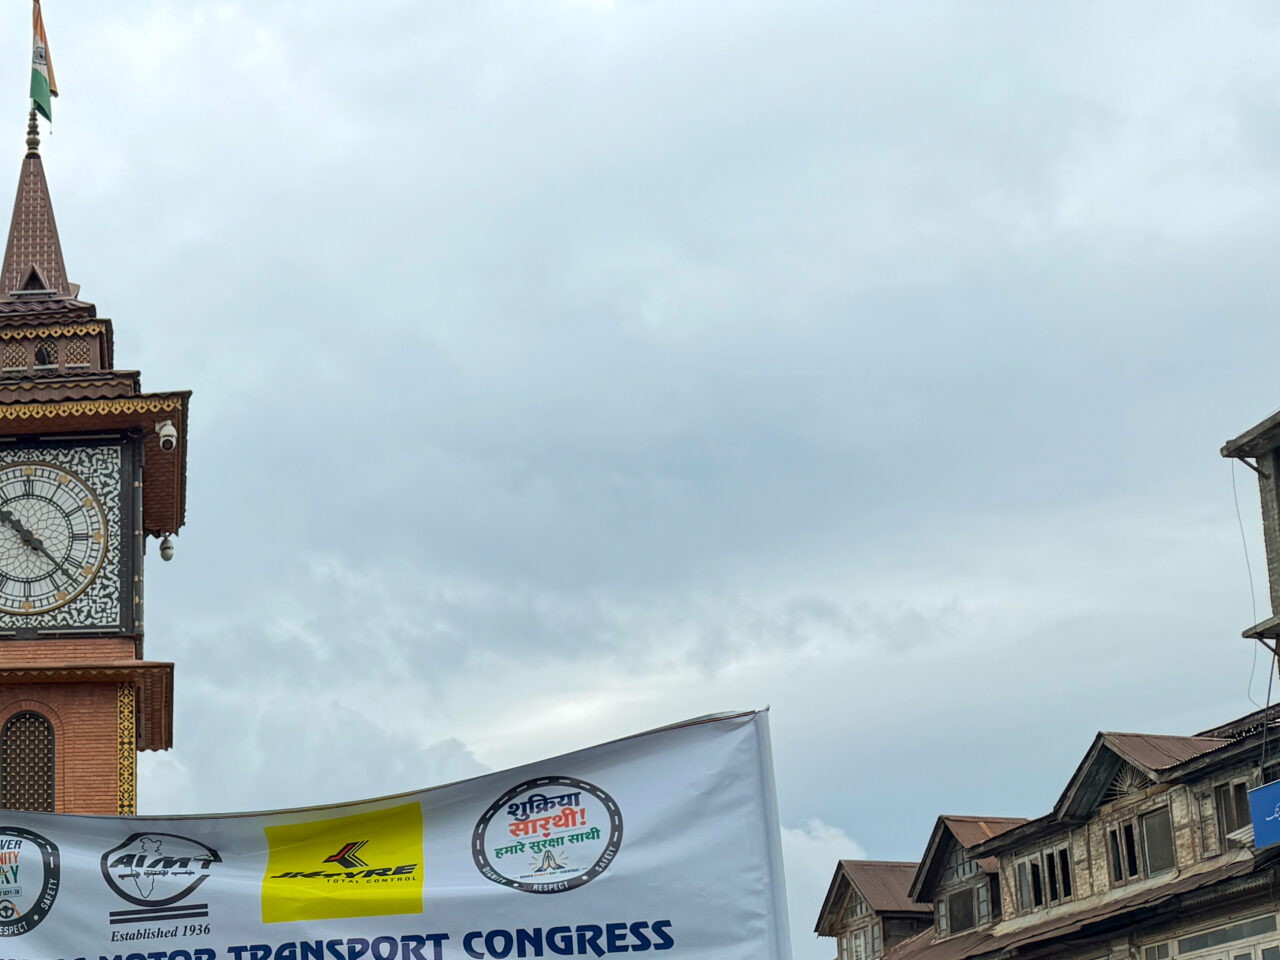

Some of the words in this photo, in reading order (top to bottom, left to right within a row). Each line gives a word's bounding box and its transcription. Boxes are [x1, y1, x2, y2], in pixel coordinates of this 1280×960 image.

[506, 791, 581, 822] शुक्रिया
[508, 806, 587, 838] सारथी!
[494, 841, 526, 859] हमारे
[529, 835, 565, 854] सुरक्षा
[567, 826, 601, 844] साथी
[595, 846, 616, 872] SAFETY
[326, 877, 359, 885] TOTAL
[366, 875, 417, 884] CONTROL
[482, 866, 507, 884] DIGNITY
[532, 881, 569, 891] RESPECT
[40, 878, 58, 910] SAFETY
[111, 926, 179, 943] Established
[181, 923, 211, 938] 1936
[462, 919, 675, 960] CONGRESS
